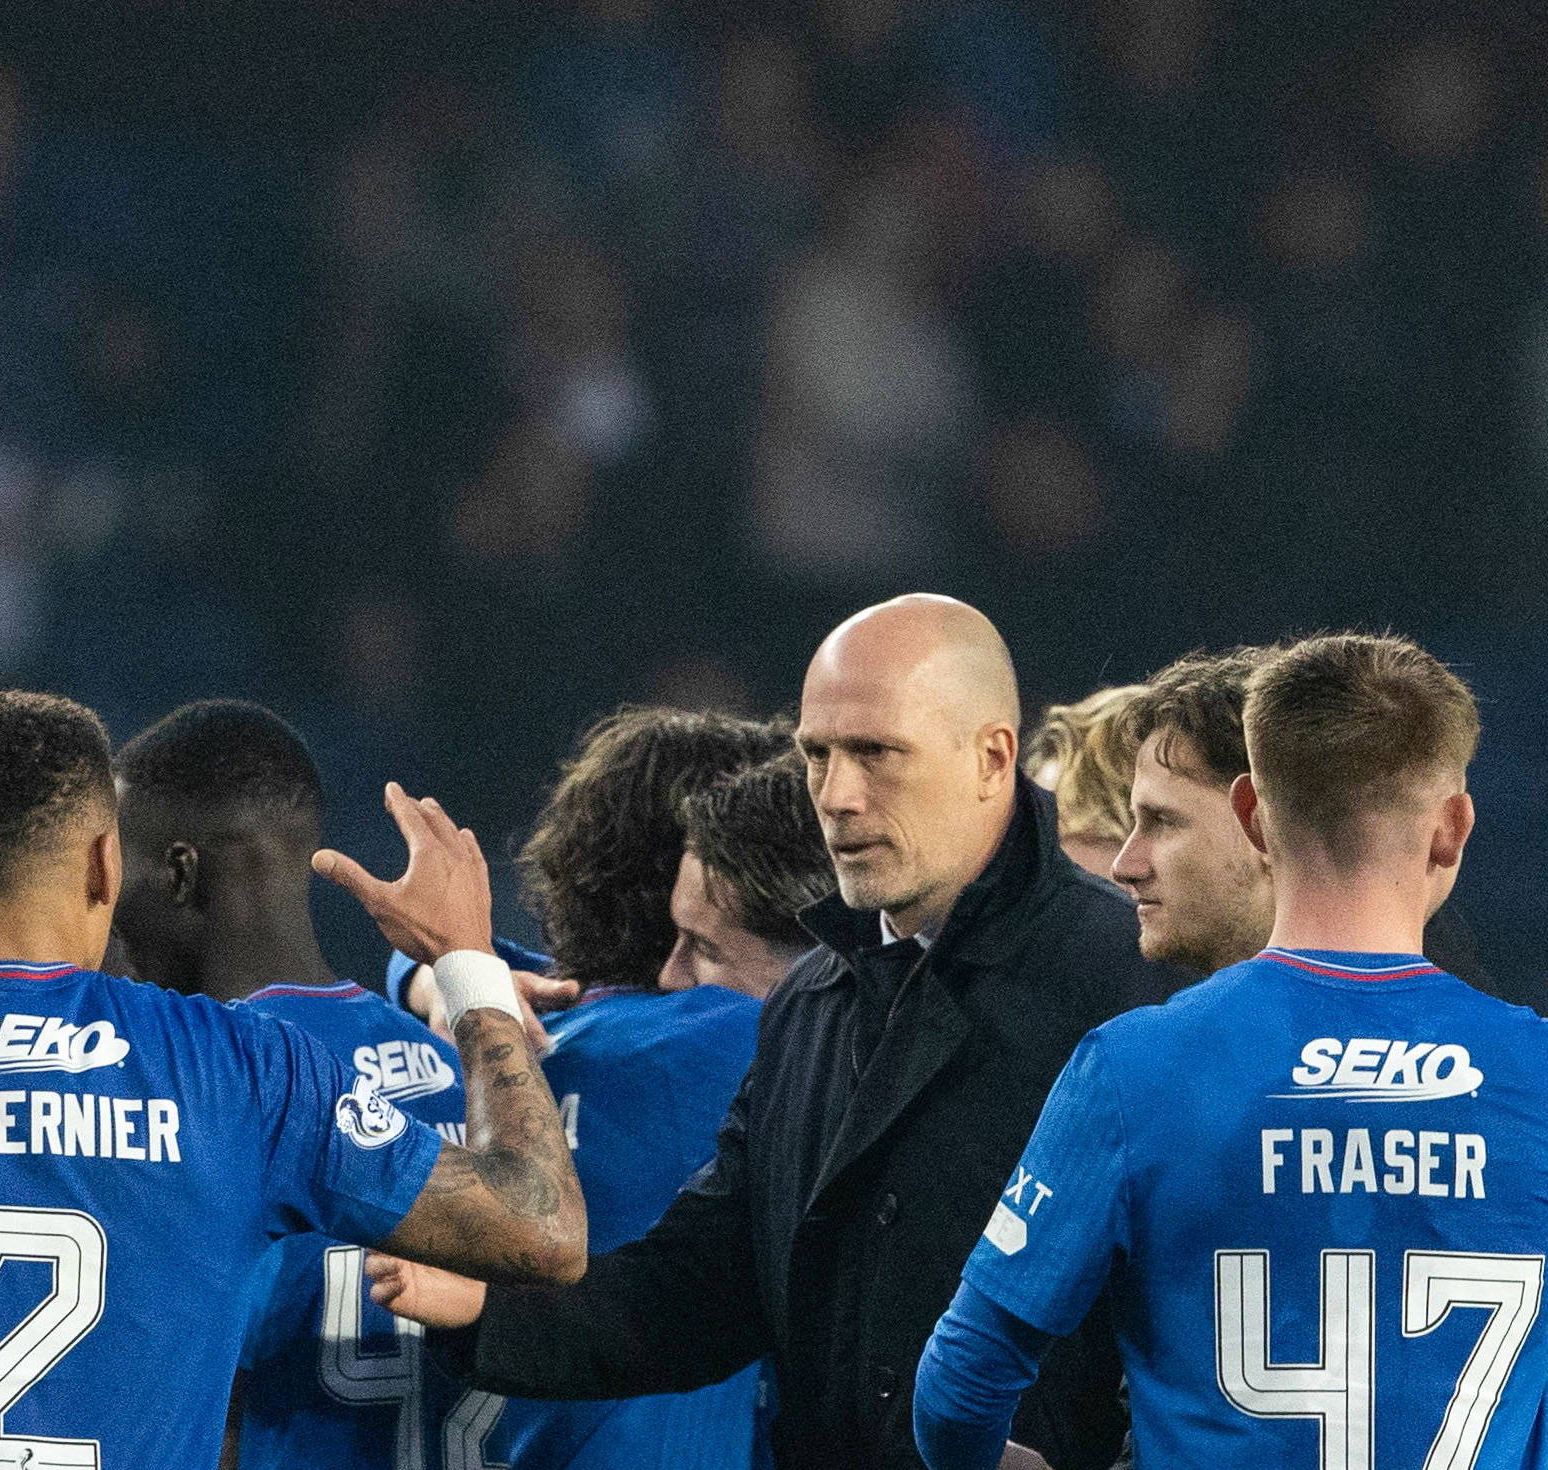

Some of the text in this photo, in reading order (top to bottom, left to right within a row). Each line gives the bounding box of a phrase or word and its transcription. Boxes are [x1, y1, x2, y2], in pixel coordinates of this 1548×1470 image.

[353, 1040, 450, 1090] SEKO
[1291, 1038, 1483, 1088] SEKO
[1261, 1128, 1487, 1200] FRASER
